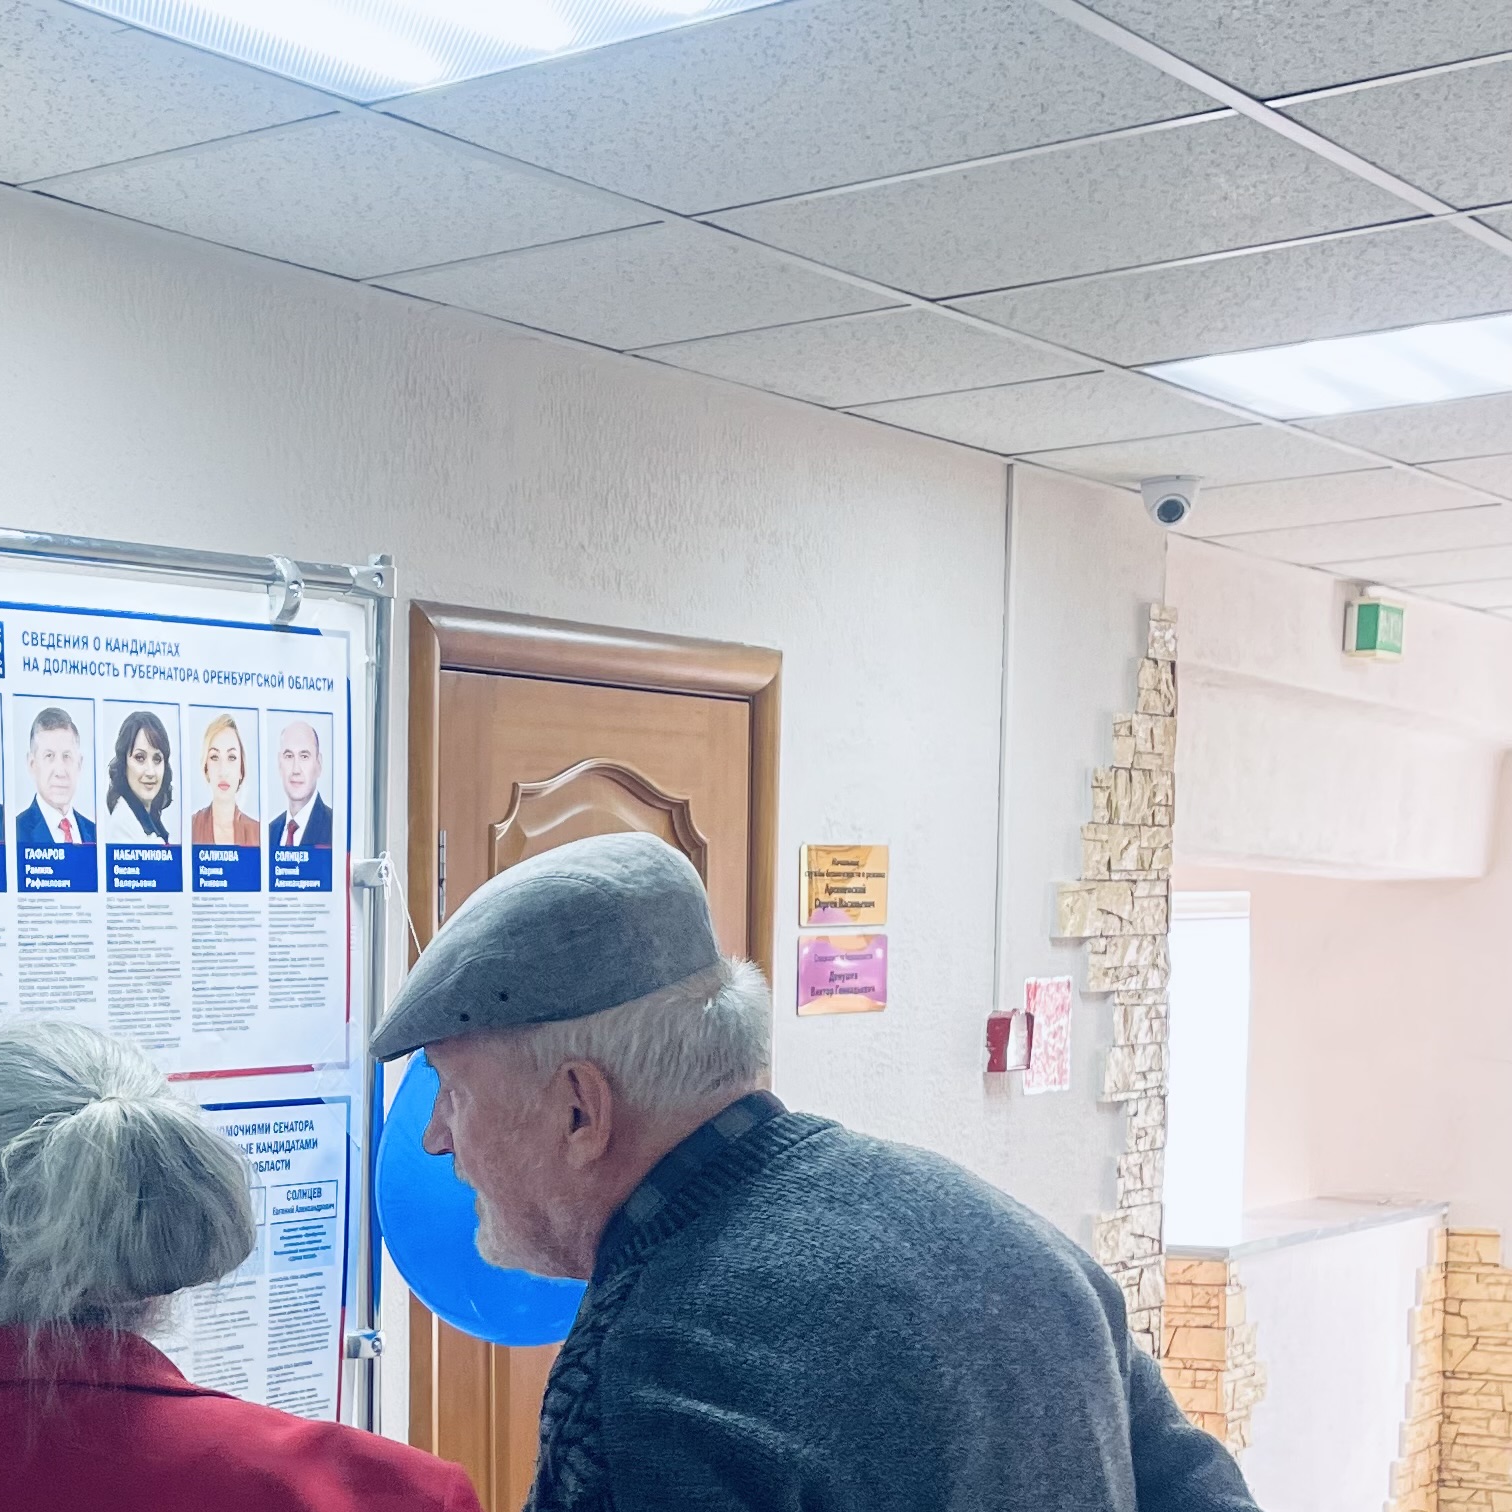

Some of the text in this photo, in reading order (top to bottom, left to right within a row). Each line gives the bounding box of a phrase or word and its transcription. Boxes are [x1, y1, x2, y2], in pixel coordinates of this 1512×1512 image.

[20, 630, 180, 657] СВЕДЕНИЯ О КАНДИДАТАХ
[22, 656, 334, 691] НА ДОЛЖНОСТЬ ГУБЕРНАТОРА ОРЕНБУРГСКОЙ ОБЛАСТИ
[24, 847, 65, 861] ГАФАРОВ
[113, 849, 173, 862] НАБАТЧИКОВА
[198, 849, 239, 862] САЛИХОВА
[274, 850, 309, 864] СОЛНЦЕВ
[273, 1119, 315, 1134] СЕНАТОРА
[256, 1138, 318, 1155] КАНДИДАТАМИ
[286, 1186, 322, 1202] СОЛНЦЕВ
